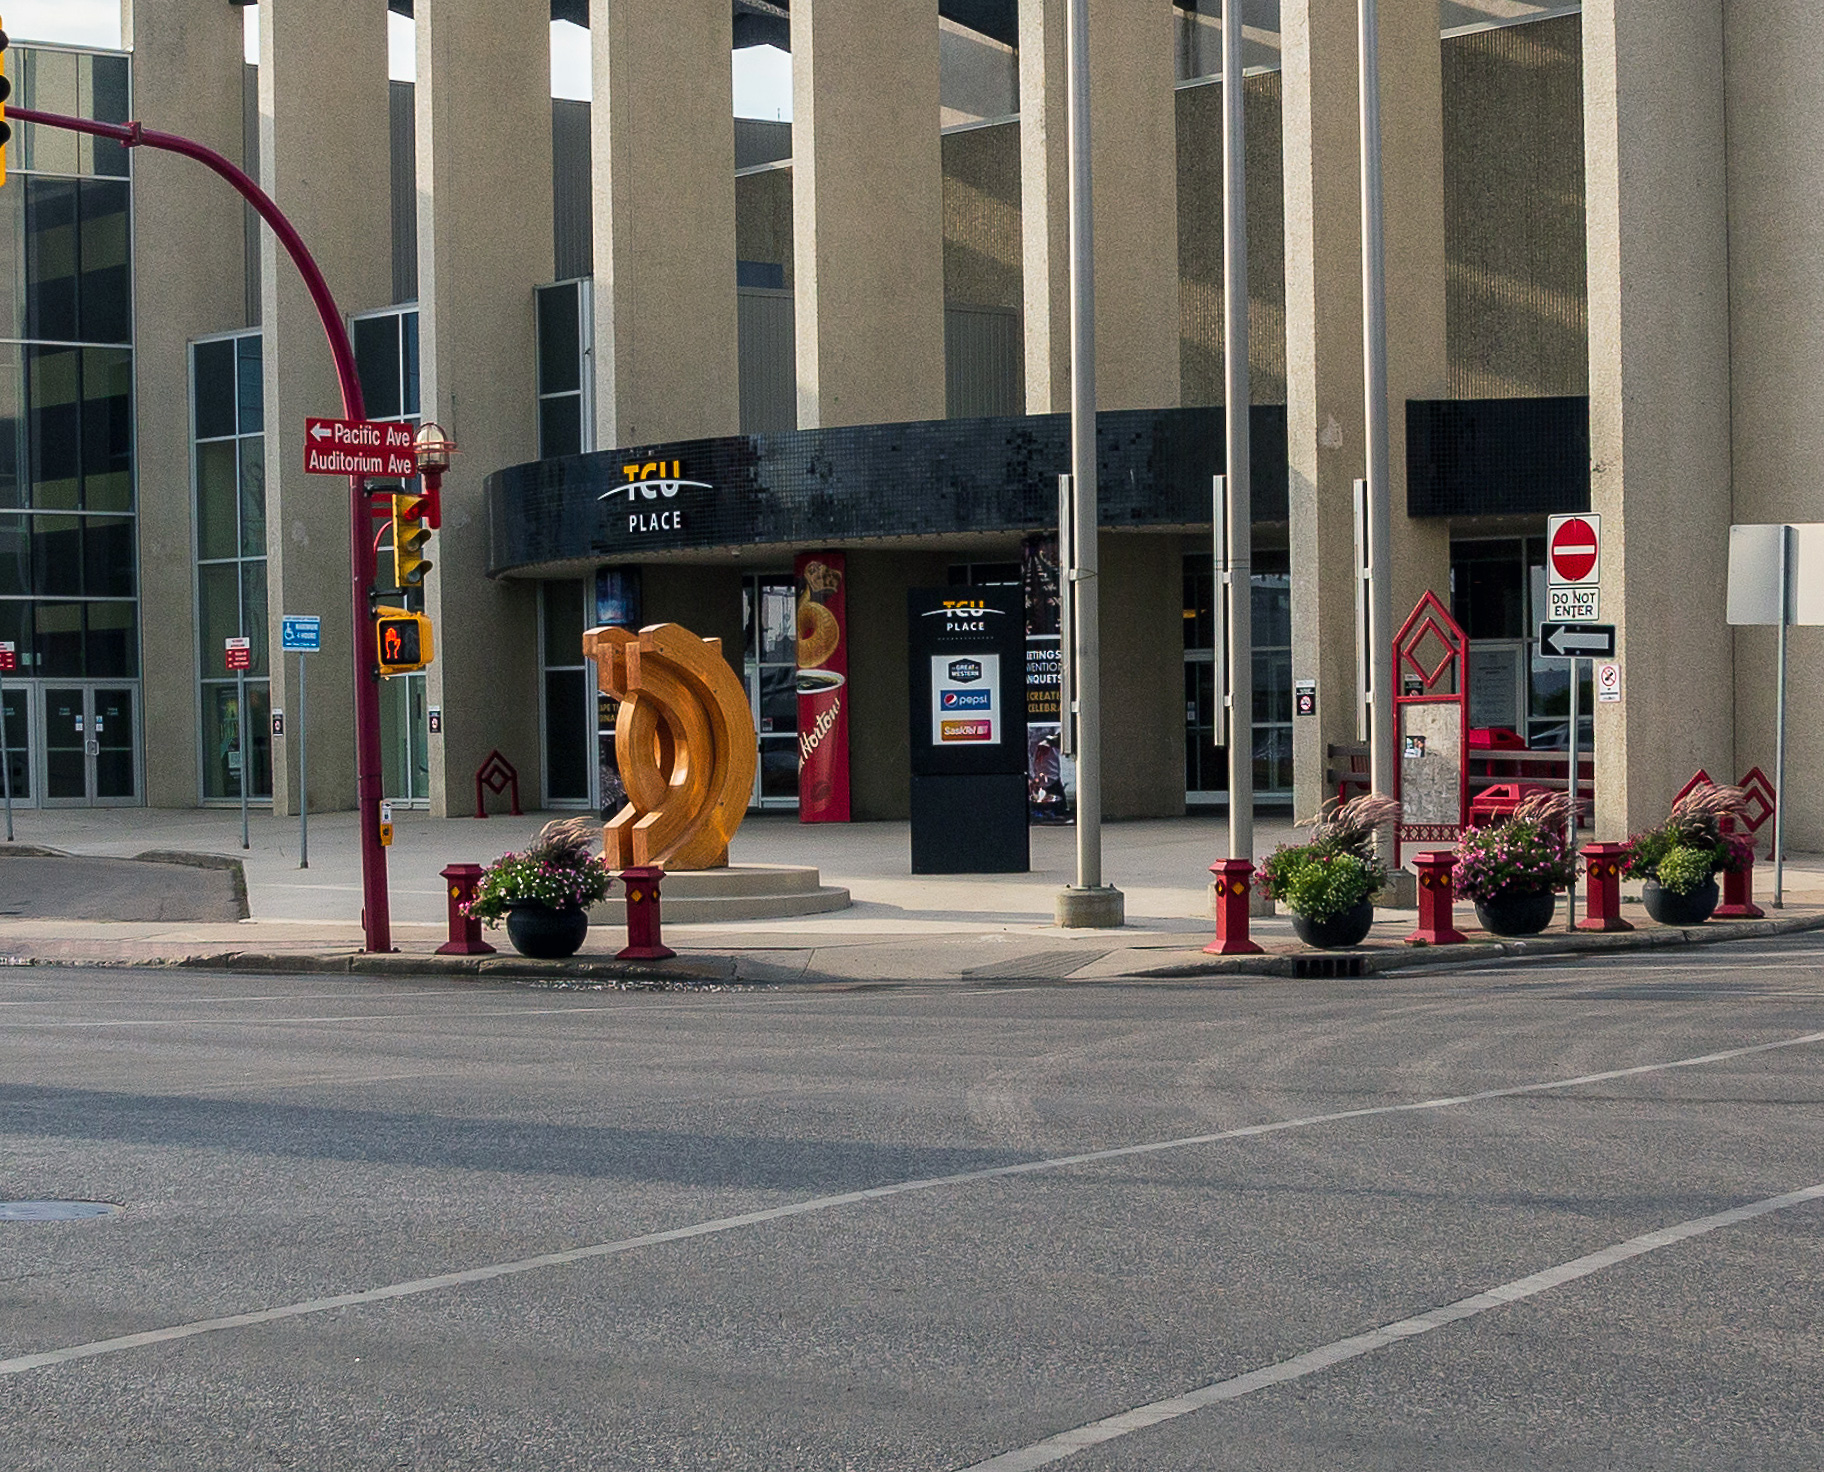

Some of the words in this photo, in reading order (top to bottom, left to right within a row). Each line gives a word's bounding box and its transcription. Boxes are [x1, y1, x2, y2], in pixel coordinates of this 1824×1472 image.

[335, 423, 380, 445] Pacific
[386, 426, 410, 447] Ave
[309, 449, 383, 473] Auditorium
[388, 454, 411, 474] Ave
[623, 460, 680, 501] TCU
[629, 511, 681, 532] PLACE
[1552, 593, 1568, 604] DO
[1573, 592, 1595, 604] NOT
[943, 600, 984, 617] TCU
[1555, 605, 1593, 616] ENTER
[947, 621, 985, 631] PLACE
[959, 694, 987, 706] pepsi
